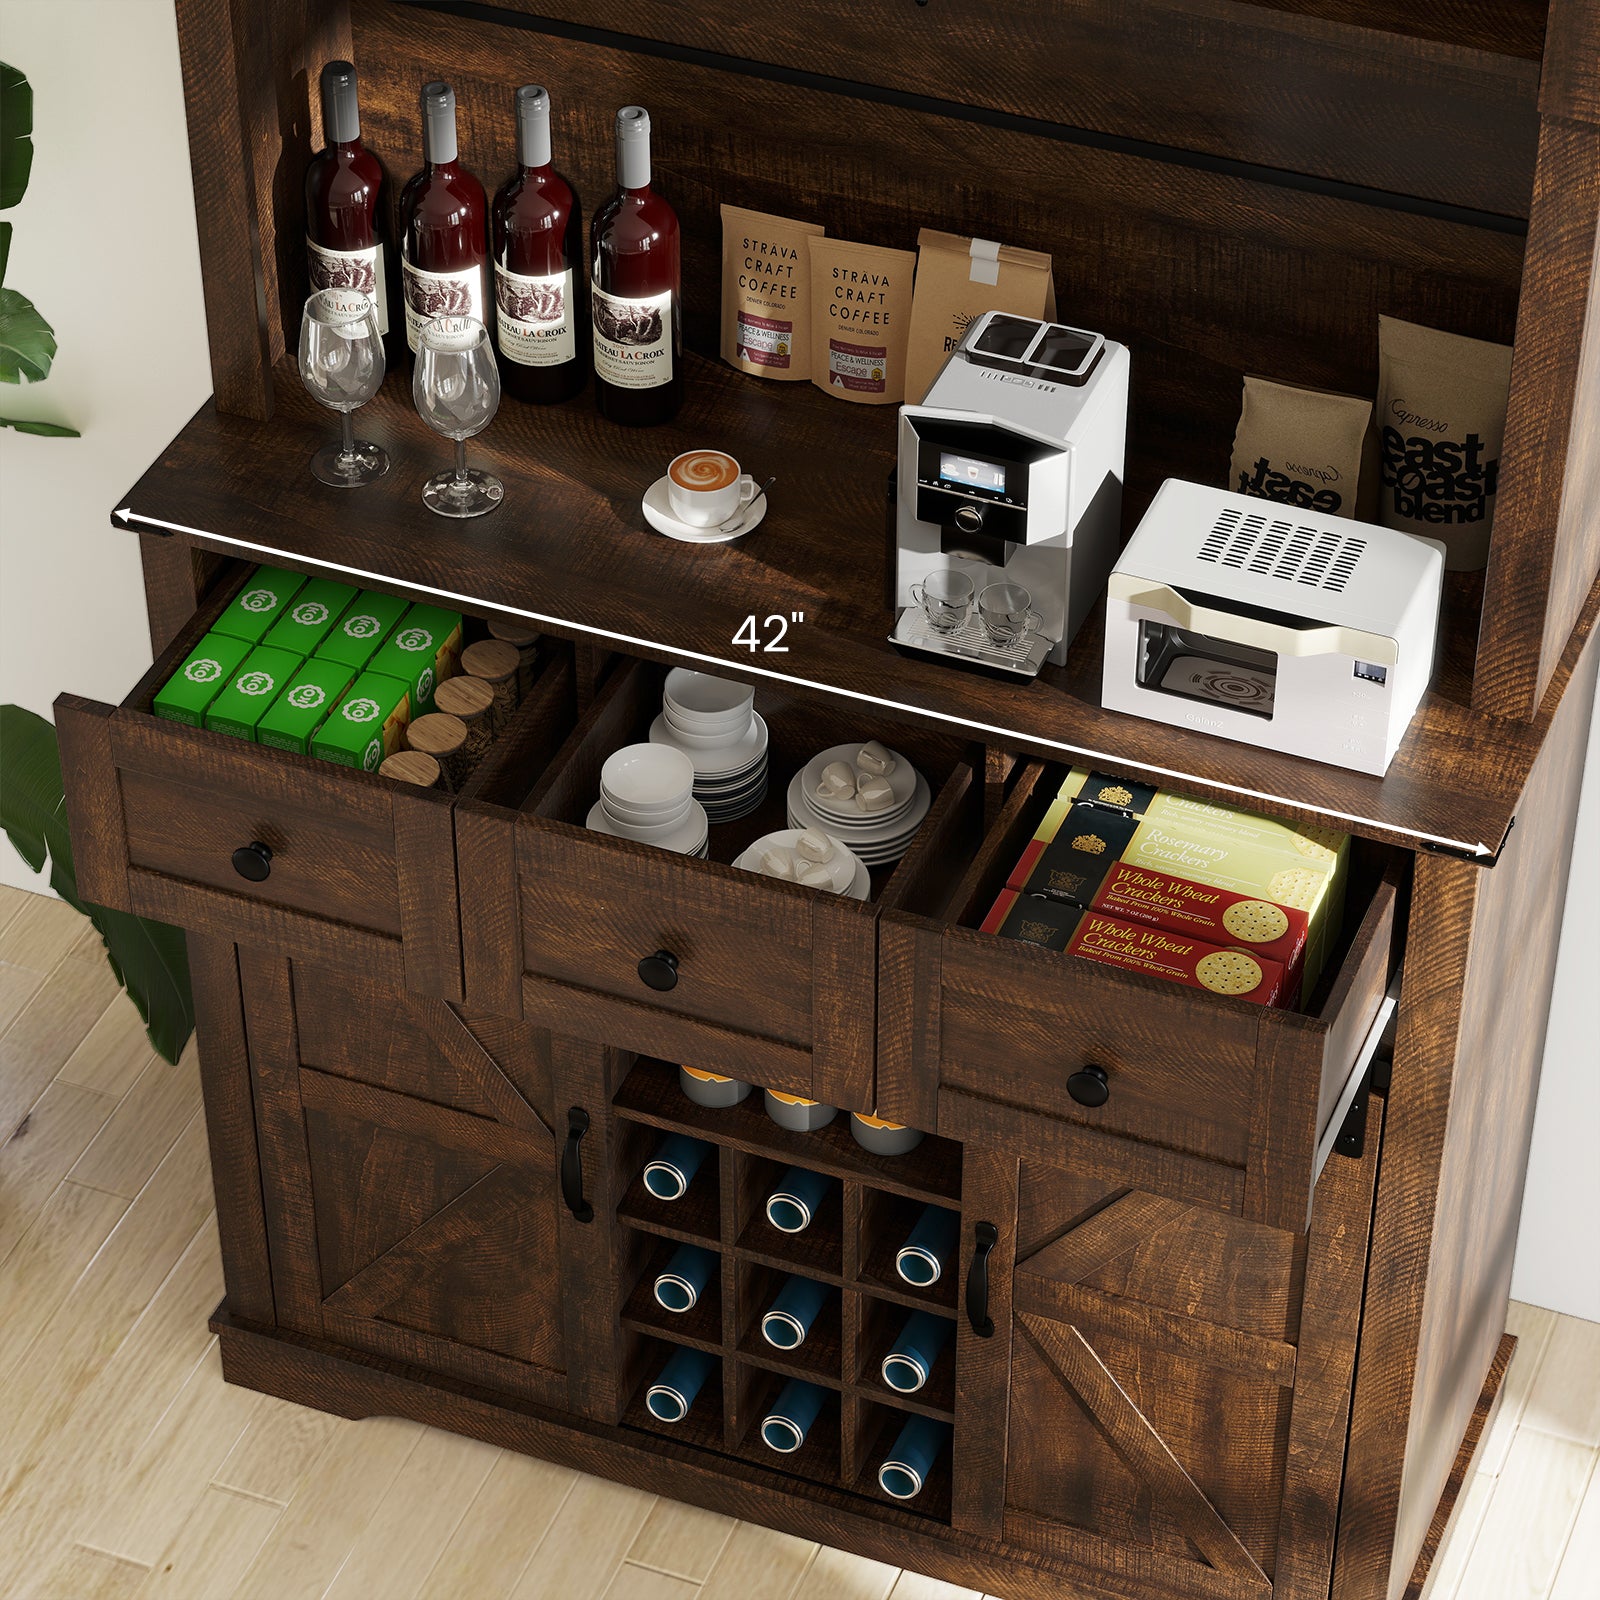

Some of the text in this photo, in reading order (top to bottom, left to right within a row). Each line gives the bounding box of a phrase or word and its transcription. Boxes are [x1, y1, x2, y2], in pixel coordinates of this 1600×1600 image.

[744, 257, 793, 278] CRAFT
[738, 275, 797, 299] COFFEE
[835, 286, 885, 305] CRAFT
[763, 300, 786, 310] COLORADO
[829, 304, 889, 325] COFFEE
[523, 328, 535, 338] LA
[536, 326, 567, 338] CROIX
[743, 333, 773, 351] Escape
[761, 329, 790, 341] WELLNESS
[855, 328, 880, 337] COLORADO
[621, 350, 633, 360] LA
[634, 349, 665, 360] CROIX
[831, 351, 849, 362] PEACE
[855, 357, 884, 366] WELLNESS
[835, 361, 868, 377] Escape
[1382, 425, 1485, 475] east
[1394, 486, 1486, 524] blend
[1165, 793, 1235, 819] Crackers
[1140, 841, 1210, 869] Crackers
[1146, 828, 1229, 862] Rosemary
[1111, 882, 1185, 909] Crackers
[1117, 869, 1220, 904] Whole Wheat
[1106, 894, 1215, 927] Baked From 100% Whole Grain
[1083, 932, 1157, 960] Crackers
[1088, 919, 1193, 955] Whole Wheat
[1078, 945, 1101, 955] Baked
[1102, 950, 1122, 961] From
[1123, 956, 1141, 966] 100%
[1143, 962, 1165, 973] Whole
[1166, 968, 1189, 978] Grain
